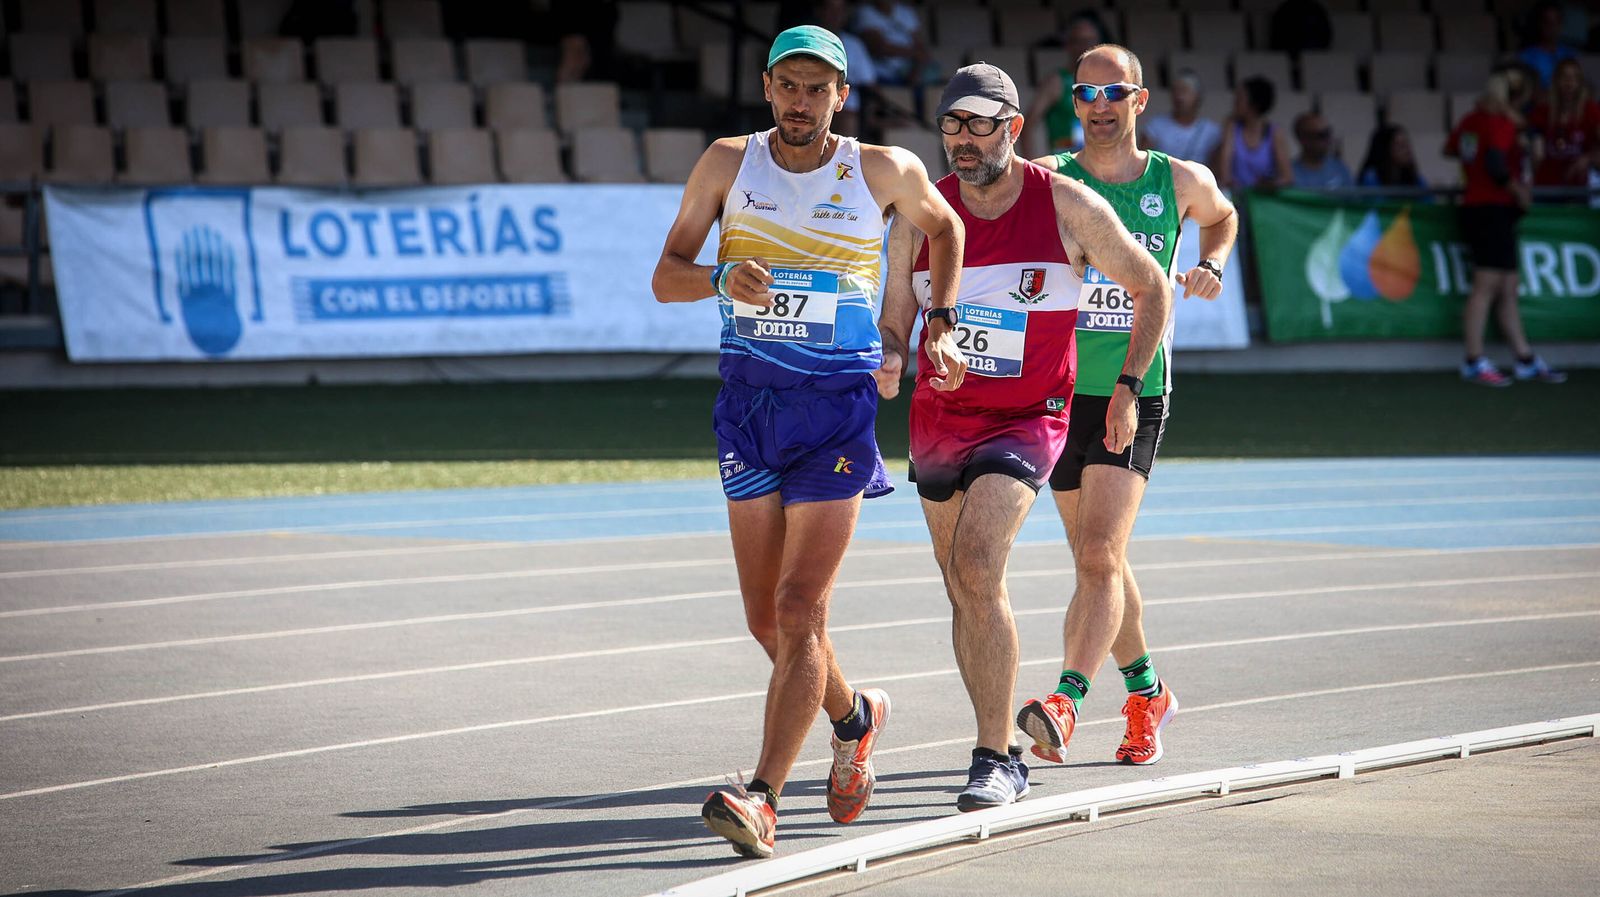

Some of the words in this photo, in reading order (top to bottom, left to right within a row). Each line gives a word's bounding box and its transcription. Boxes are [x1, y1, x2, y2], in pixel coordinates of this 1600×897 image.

[279, 192, 563, 258] LOTERÍAS
[774, 271, 813, 281] LOTERÍAS
[320, 285, 379, 313] CON
[384, 284, 417, 311] EL
[421, 282, 541, 311] DEPORTE
[965, 307, 1003, 319] LOTERÍAS
